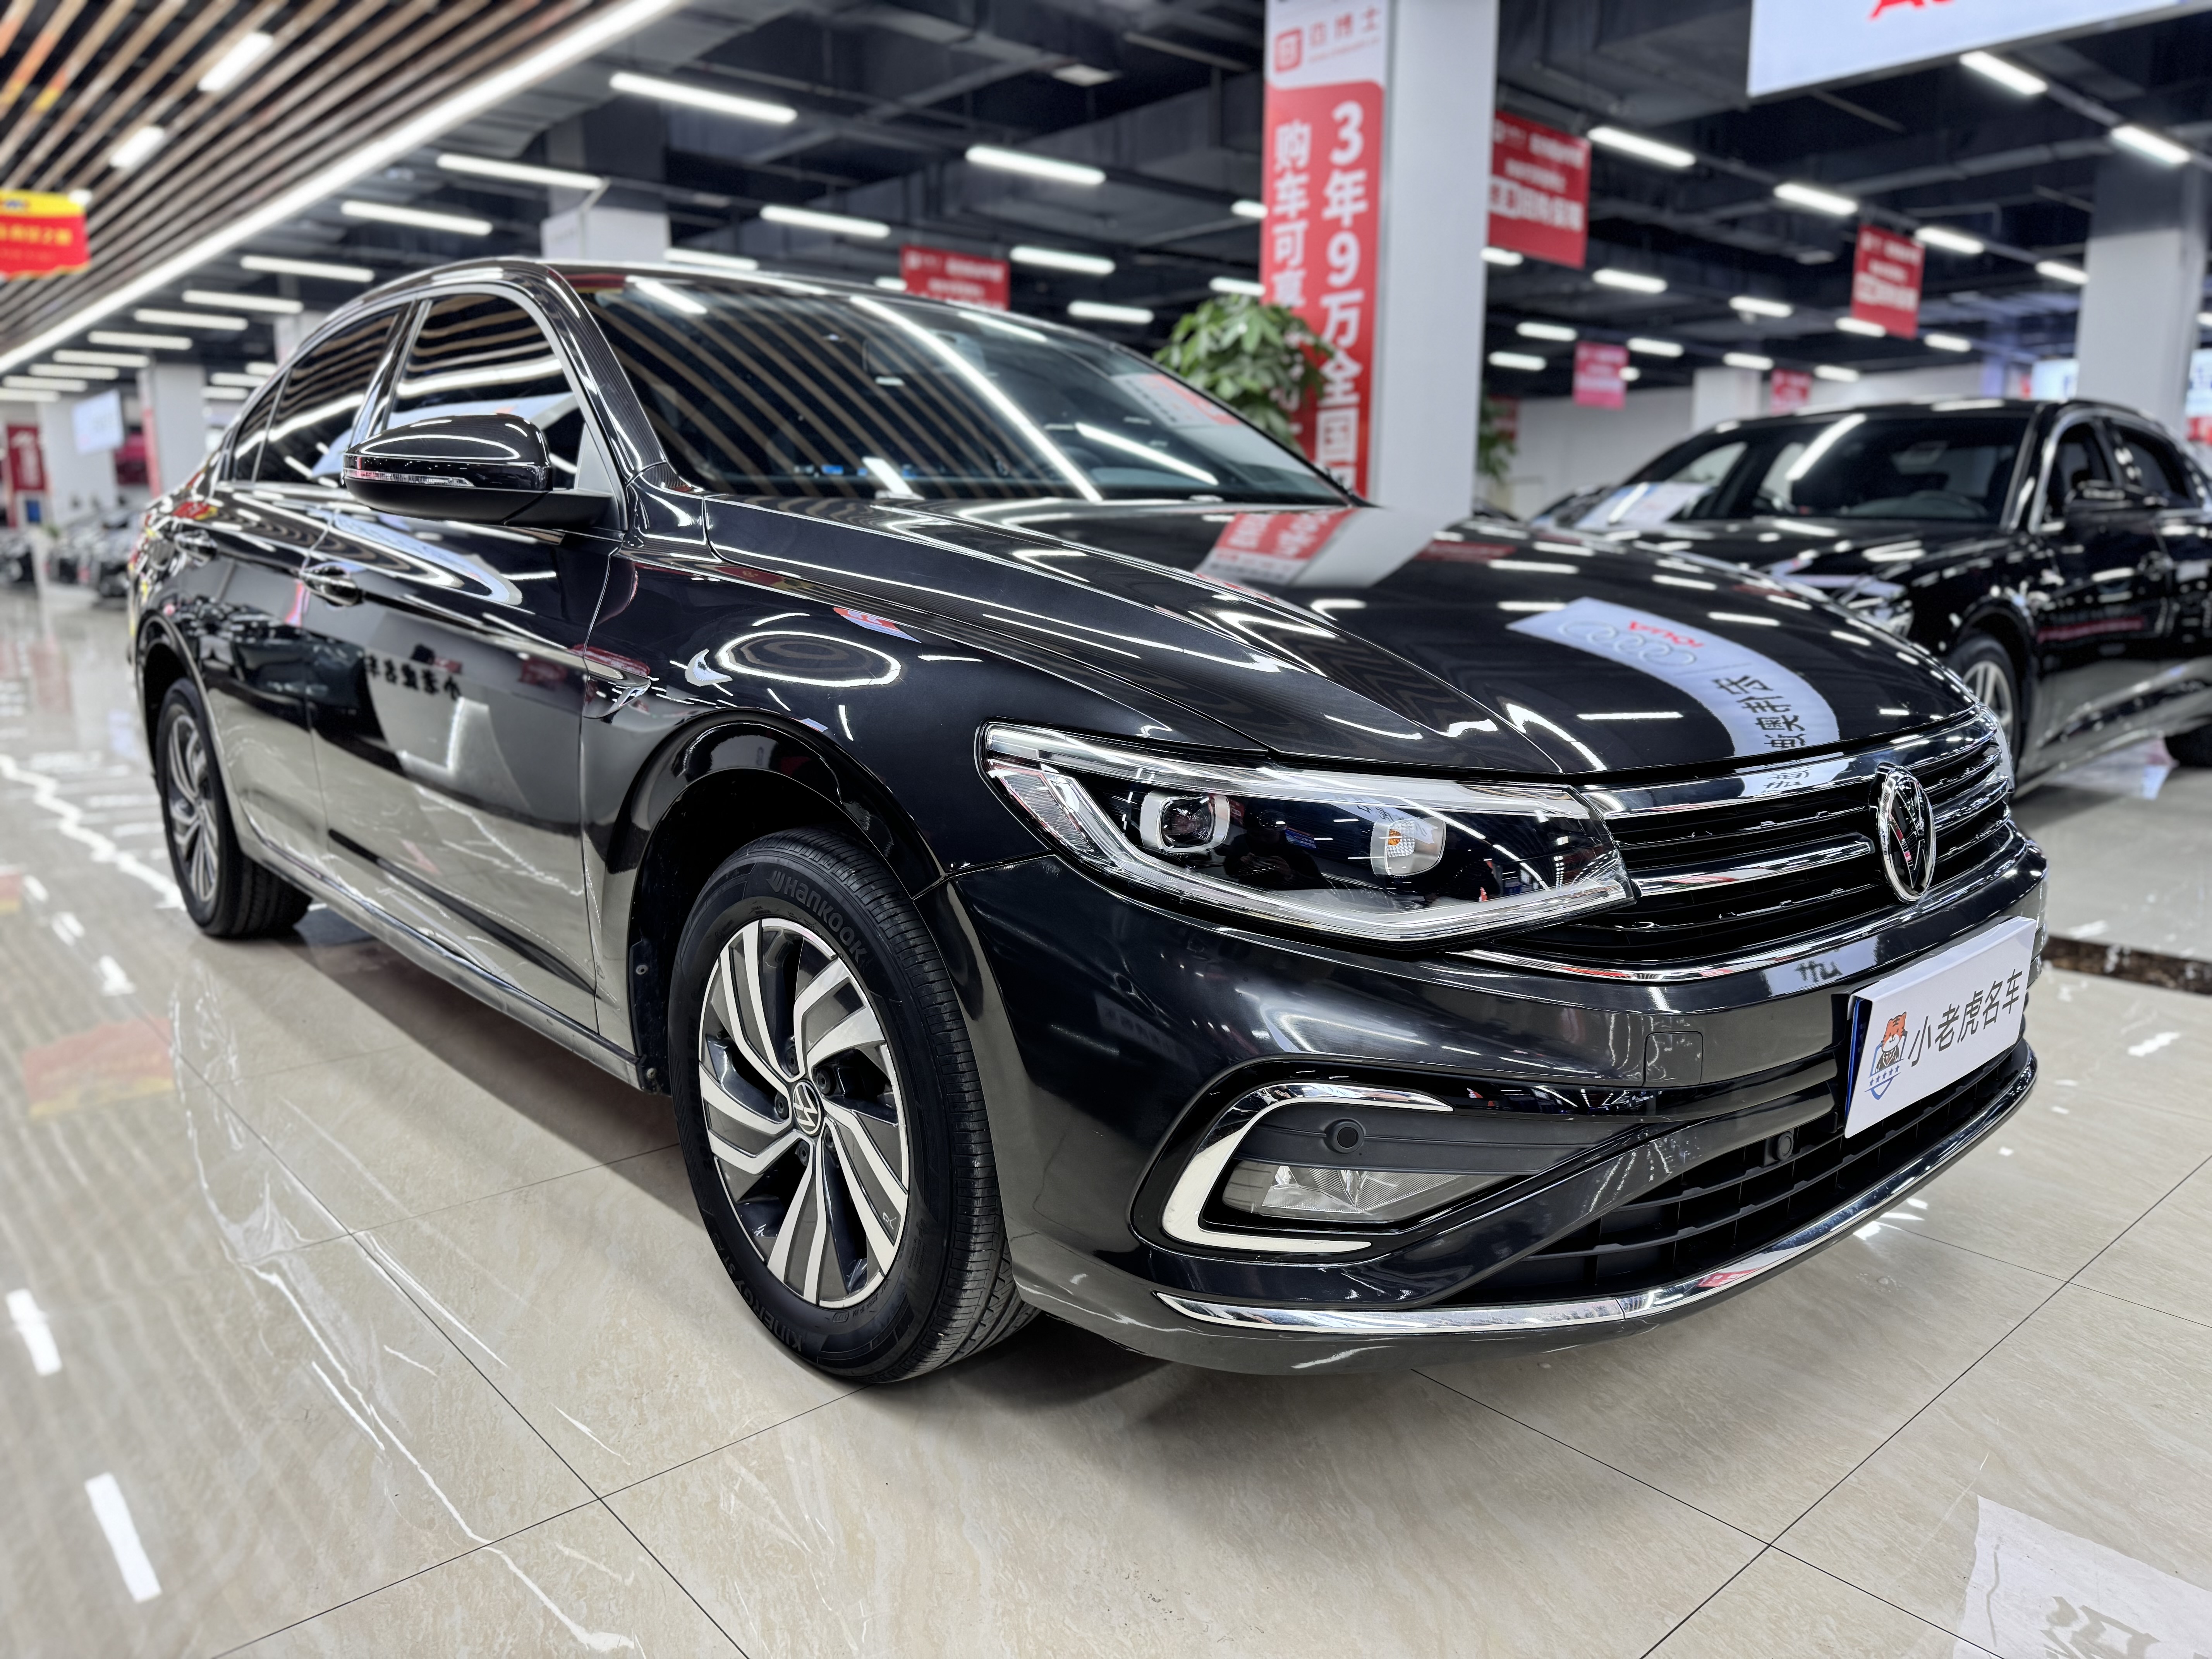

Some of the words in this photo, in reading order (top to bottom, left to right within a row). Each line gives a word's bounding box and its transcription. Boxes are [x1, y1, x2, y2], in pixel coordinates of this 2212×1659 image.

[1908, 968, 2023, 1067] 小老虎名车
